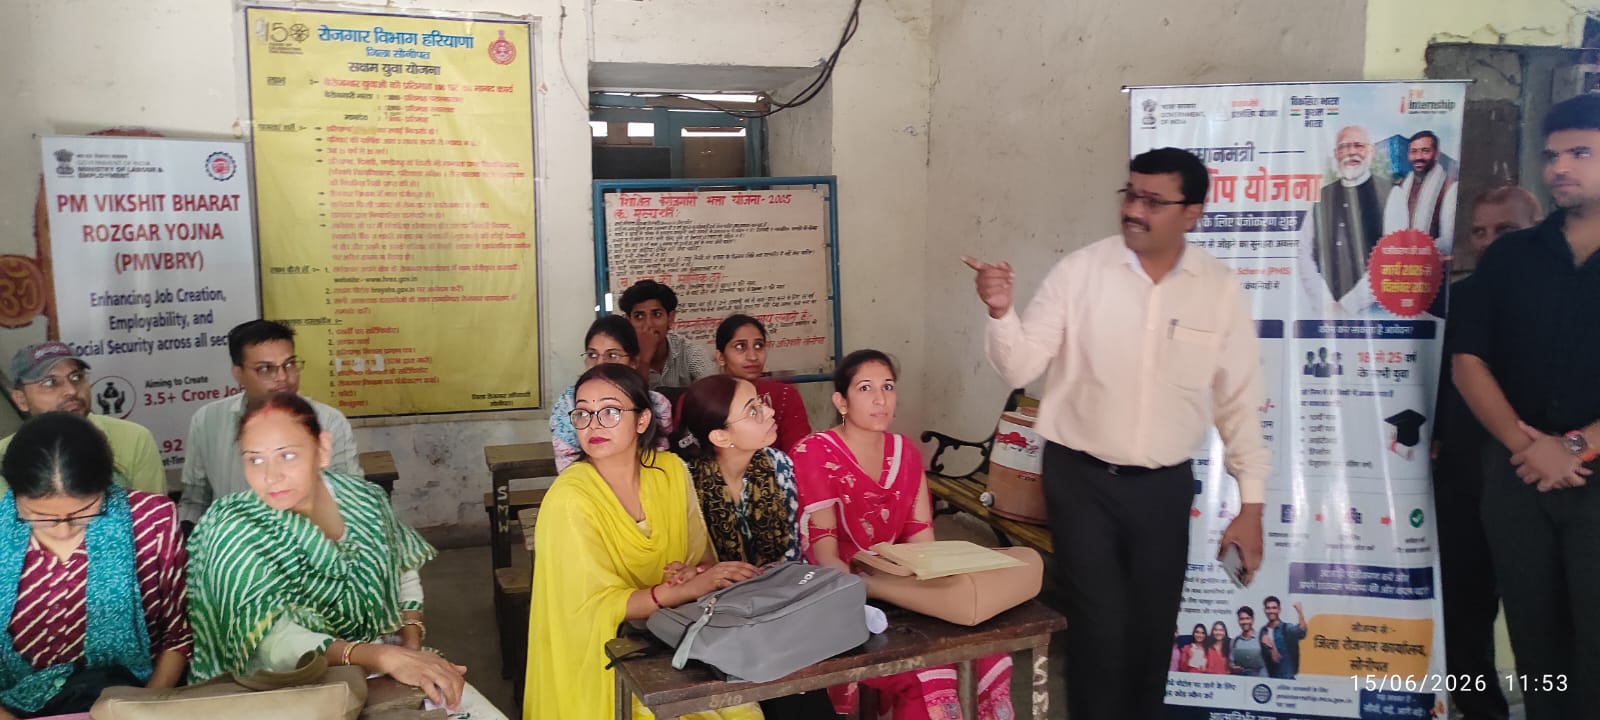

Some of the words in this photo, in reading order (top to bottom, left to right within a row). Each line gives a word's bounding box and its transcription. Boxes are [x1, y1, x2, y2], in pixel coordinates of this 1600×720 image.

[318, 24, 369, 44] रोजगार
[373, 26, 418, 47] विभाग
[422, 32, 474, 49] हरियाणा
[382, 62, 402, 78] युवा
[404, 62, 441, 76] योजना
[1186, 141, 1255, 163] धानमंत्री
[1244, 166, 1323, 203] योजना
[57, 194, 88, 213] PM
[94, 194, 166, 213] VIKSHIT
[172, 193, 240, 212] BHARAT
[1213, 214, 1234, 228] लिए
[83, 223, 160, 243] ROZGAR
[164, 223, 224, 241] YOJNA
[115, 251, 204, 275] (PMVBRY)
[90, 292, 151, 310] Enhancing
[154, 291, 174, 304] Job
[176, 288, 226, 304] Creation,
[109, 313, 189, 333] Employability,
[193, 310, 214, 325] and
[107, 338, 153, 356] Security
[157, 337, 189, 350] across
[194, 333, 207, 348] all
[1387, 351, 1403, 364] 25
[145, 379, 172, 389] Aiming
[174, 378, 182, 386] to
[184, 376, 208, 385] Create
[144, 392, 177, 406] 3.5+
[182, 388, 219, 402] Crore
[1313, 634, 1340, 650] जिला
[1342, 636, 1378, 652] रोजगार
[1380, 641, 1426, 657] कार्यालय,
[1348, 656, 1389, 673] सोनीपत
